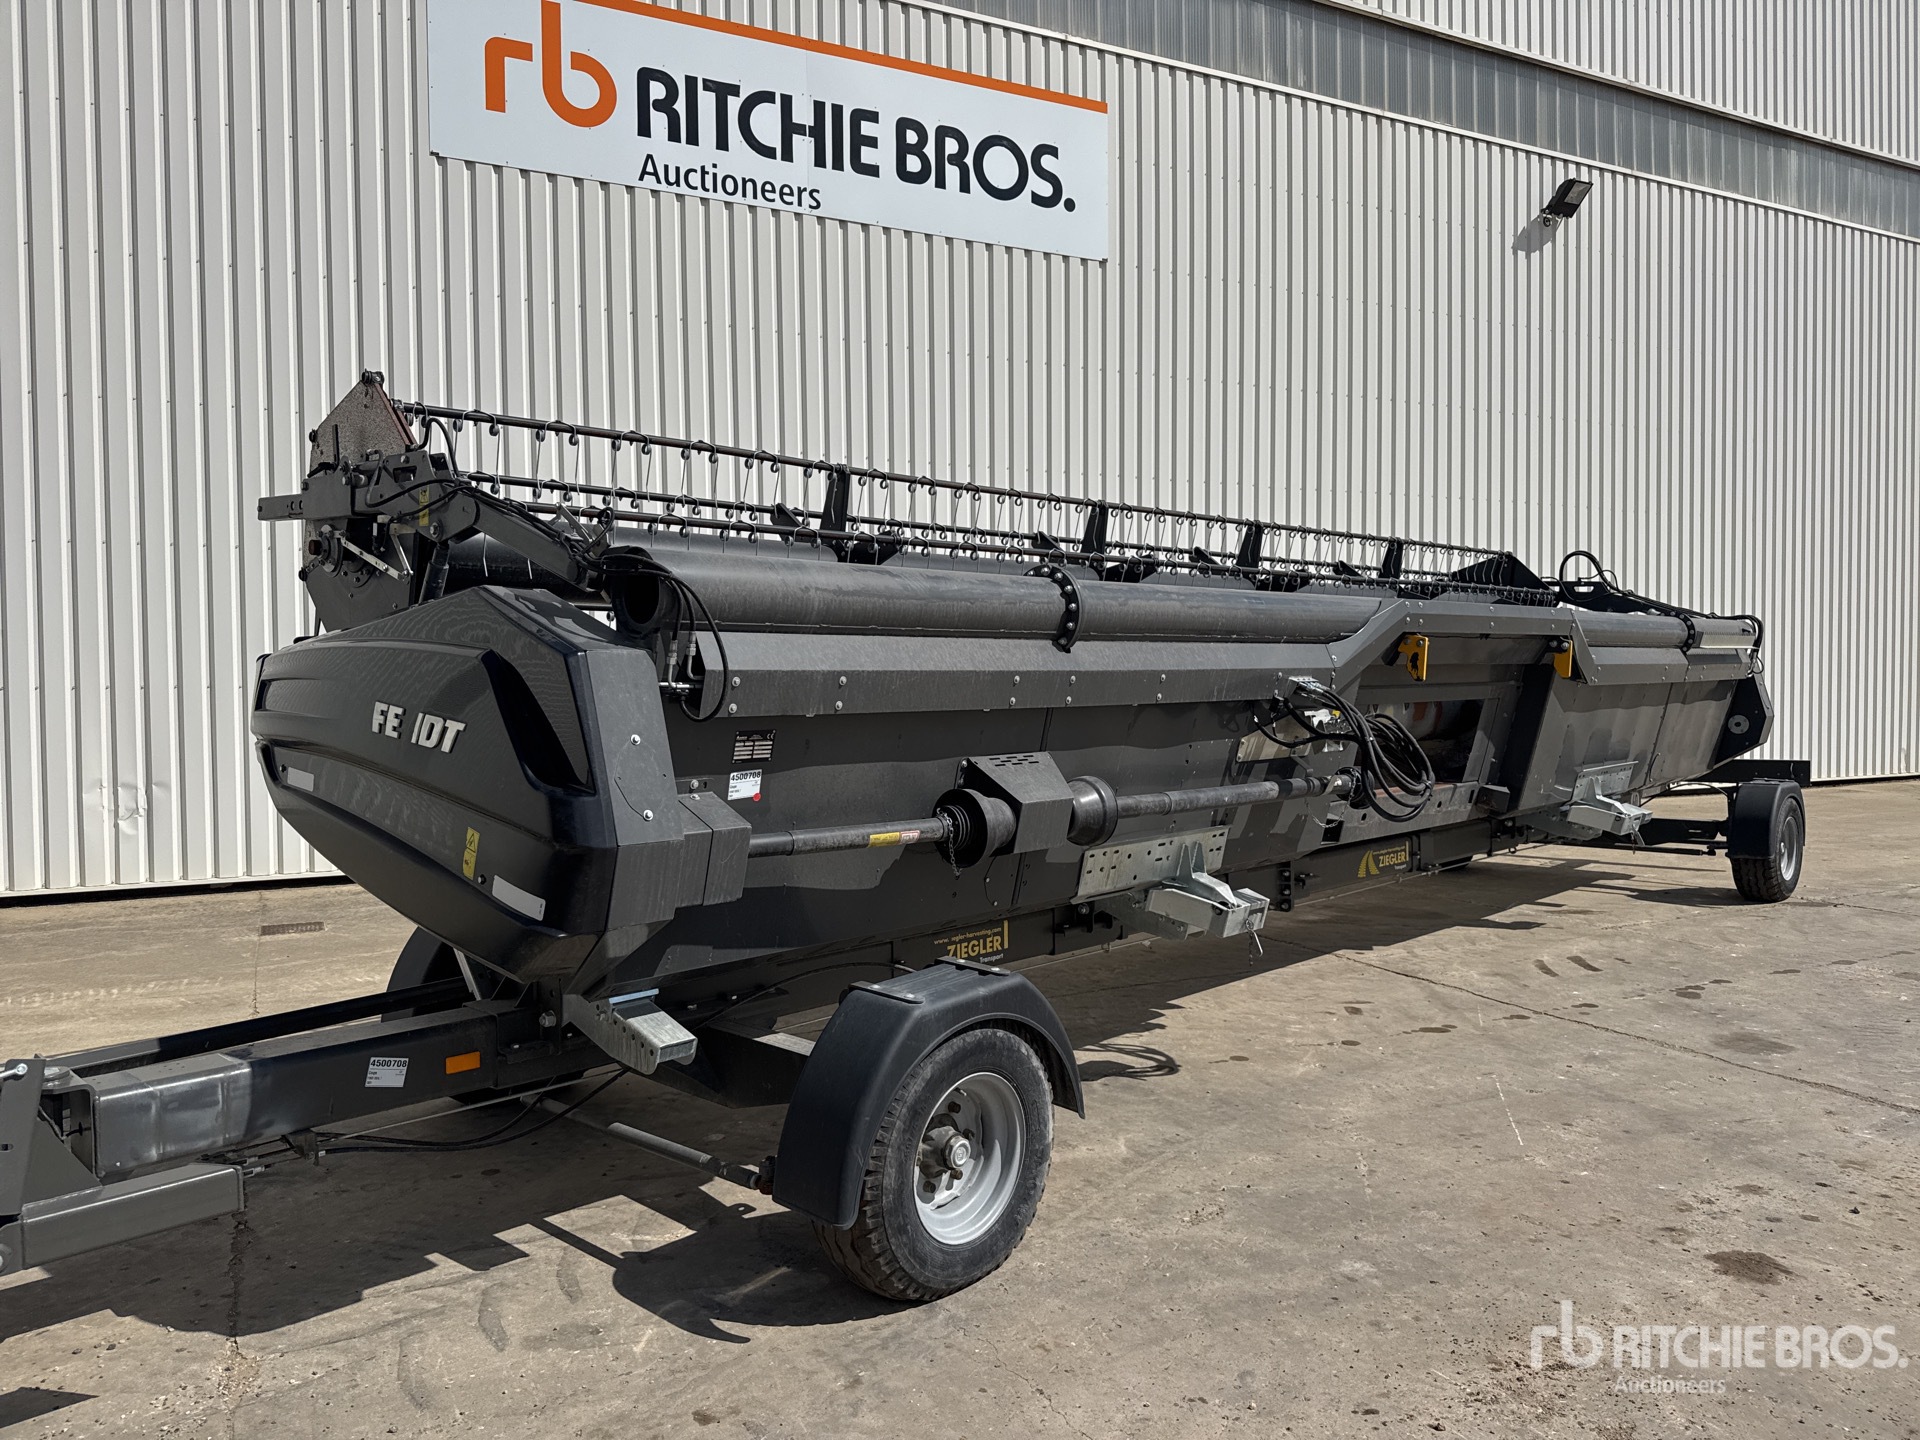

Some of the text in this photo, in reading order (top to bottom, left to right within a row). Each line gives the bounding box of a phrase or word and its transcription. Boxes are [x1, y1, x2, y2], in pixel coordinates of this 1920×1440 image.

[636, 66, 1076, 212] RITCHIE BROS.
[638, 153, 822, 211] Auctioneers
[730, 771, 761, 782] 4500708
[1378, 851, 1406, 867] ZIEGLER
[946, 935, 1002, 959] ZIEGLER
[979, 953, 1004, 964] Transport
[370, 1059, 408, 1068] 4500708
